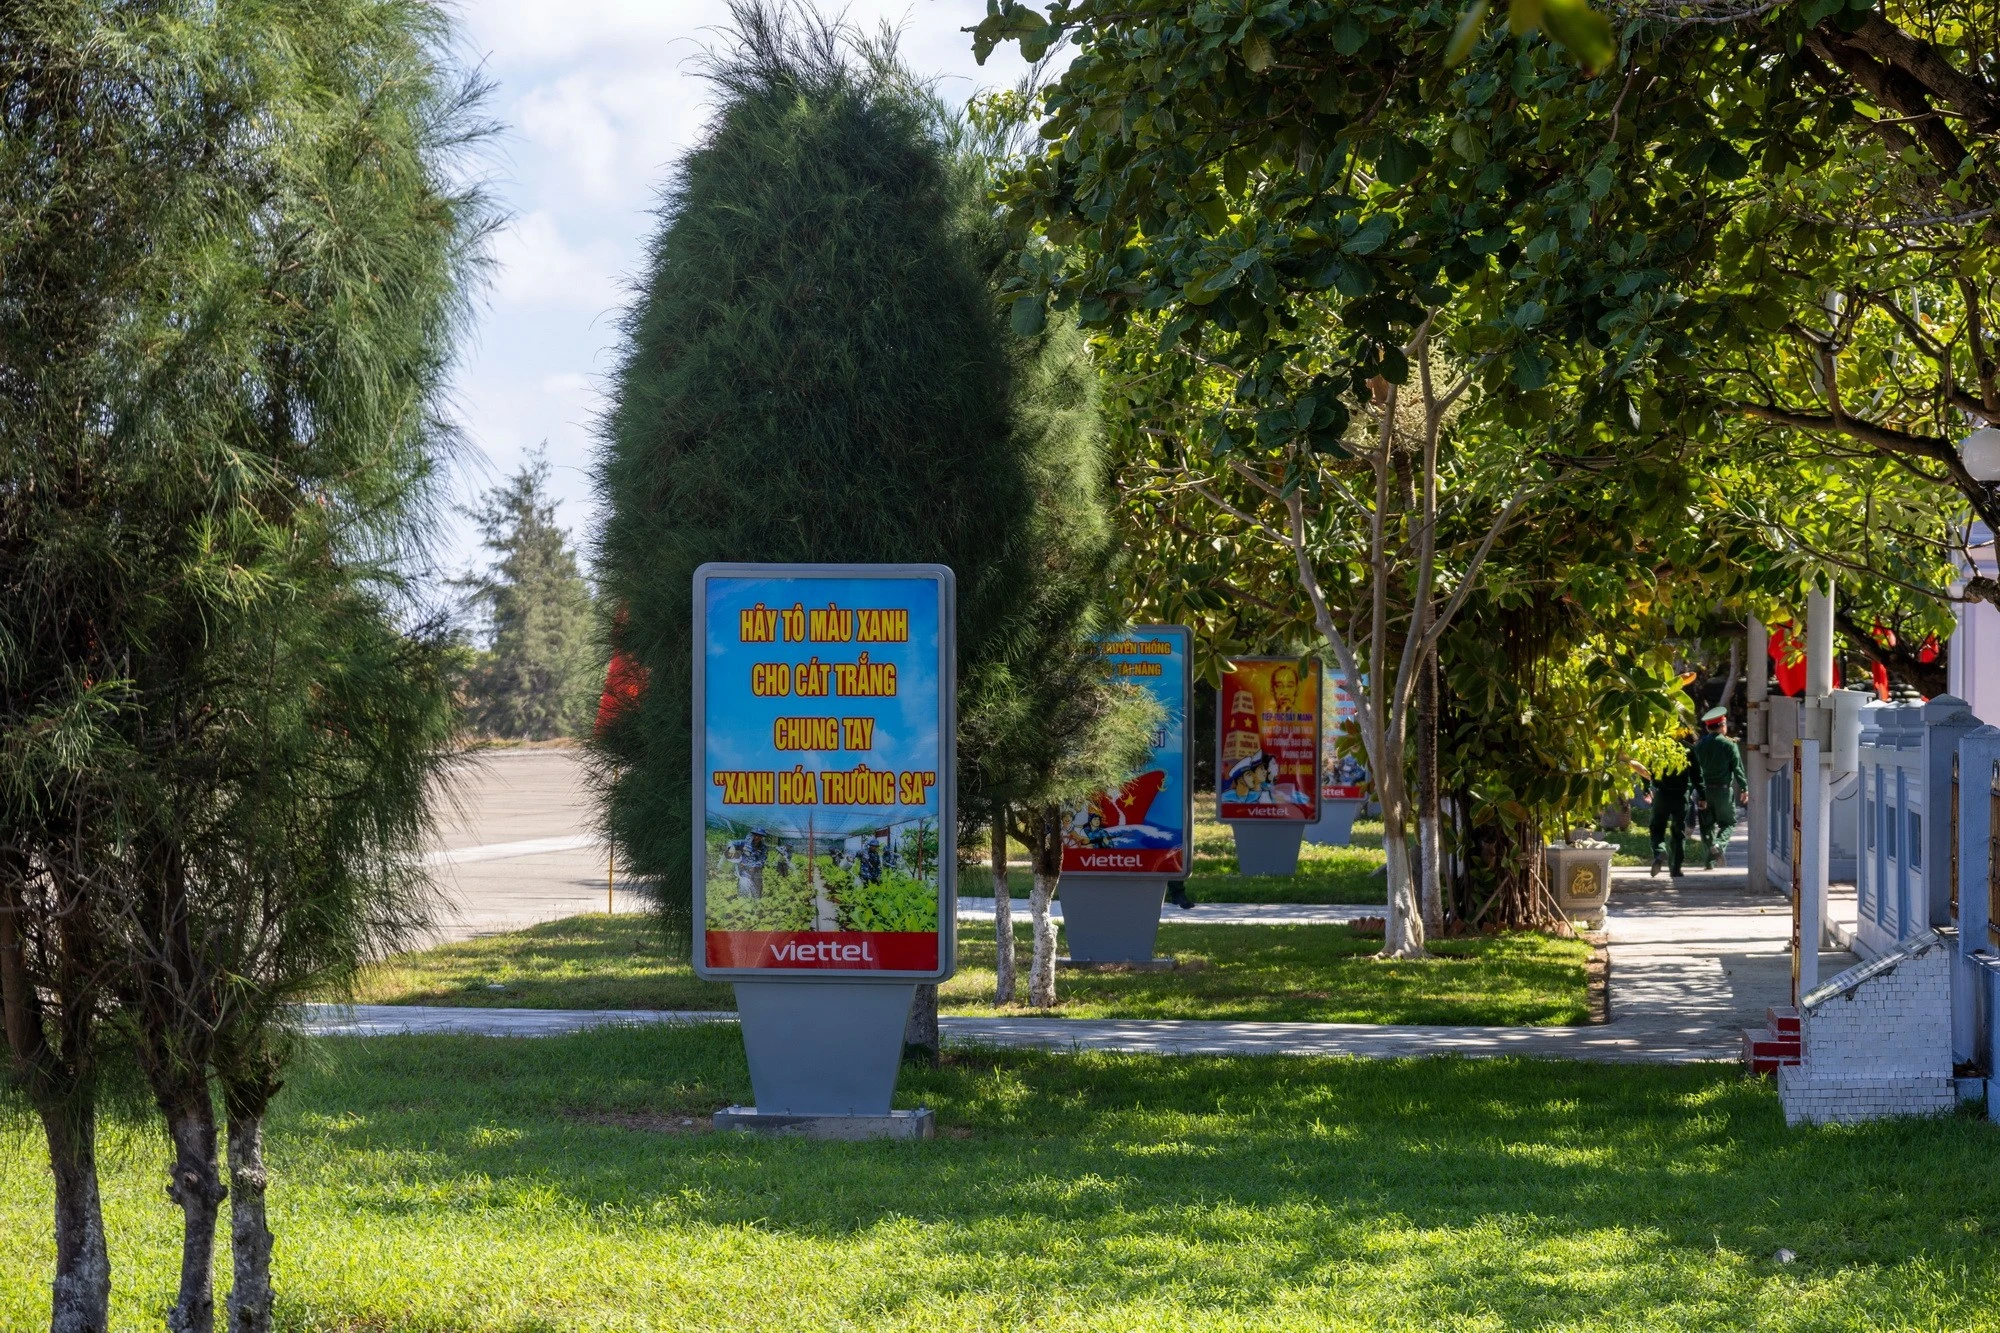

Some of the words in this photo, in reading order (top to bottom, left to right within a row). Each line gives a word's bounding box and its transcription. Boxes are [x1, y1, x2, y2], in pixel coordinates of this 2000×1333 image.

[740, 602, 778, 643] HÃY
[781, 603, 805, 643] TÔ
[809, 602, 853, 643] MÀU
[856, 609, 909, 643] XANH
[1139, 638, 1171, 654] THỐNG
[751, 663, 791, 697] CHO
[794, 656, 831, 697] CÁT
[834, 651, 897, 697] TRẮNG
[774, 717, 839, 750] CHUNG
[842, 717, 875, 750] TAY
[778, 765, 818, 805] HÓA
[820, 764, 895, 805] TRƯỜNG
[1321, 788, 1345, 797] ettel
[1248, 806, 1290, 817] viettel
[1080, 853, 1143, 867] viettel
[770, 940, 873, 961] viettel
